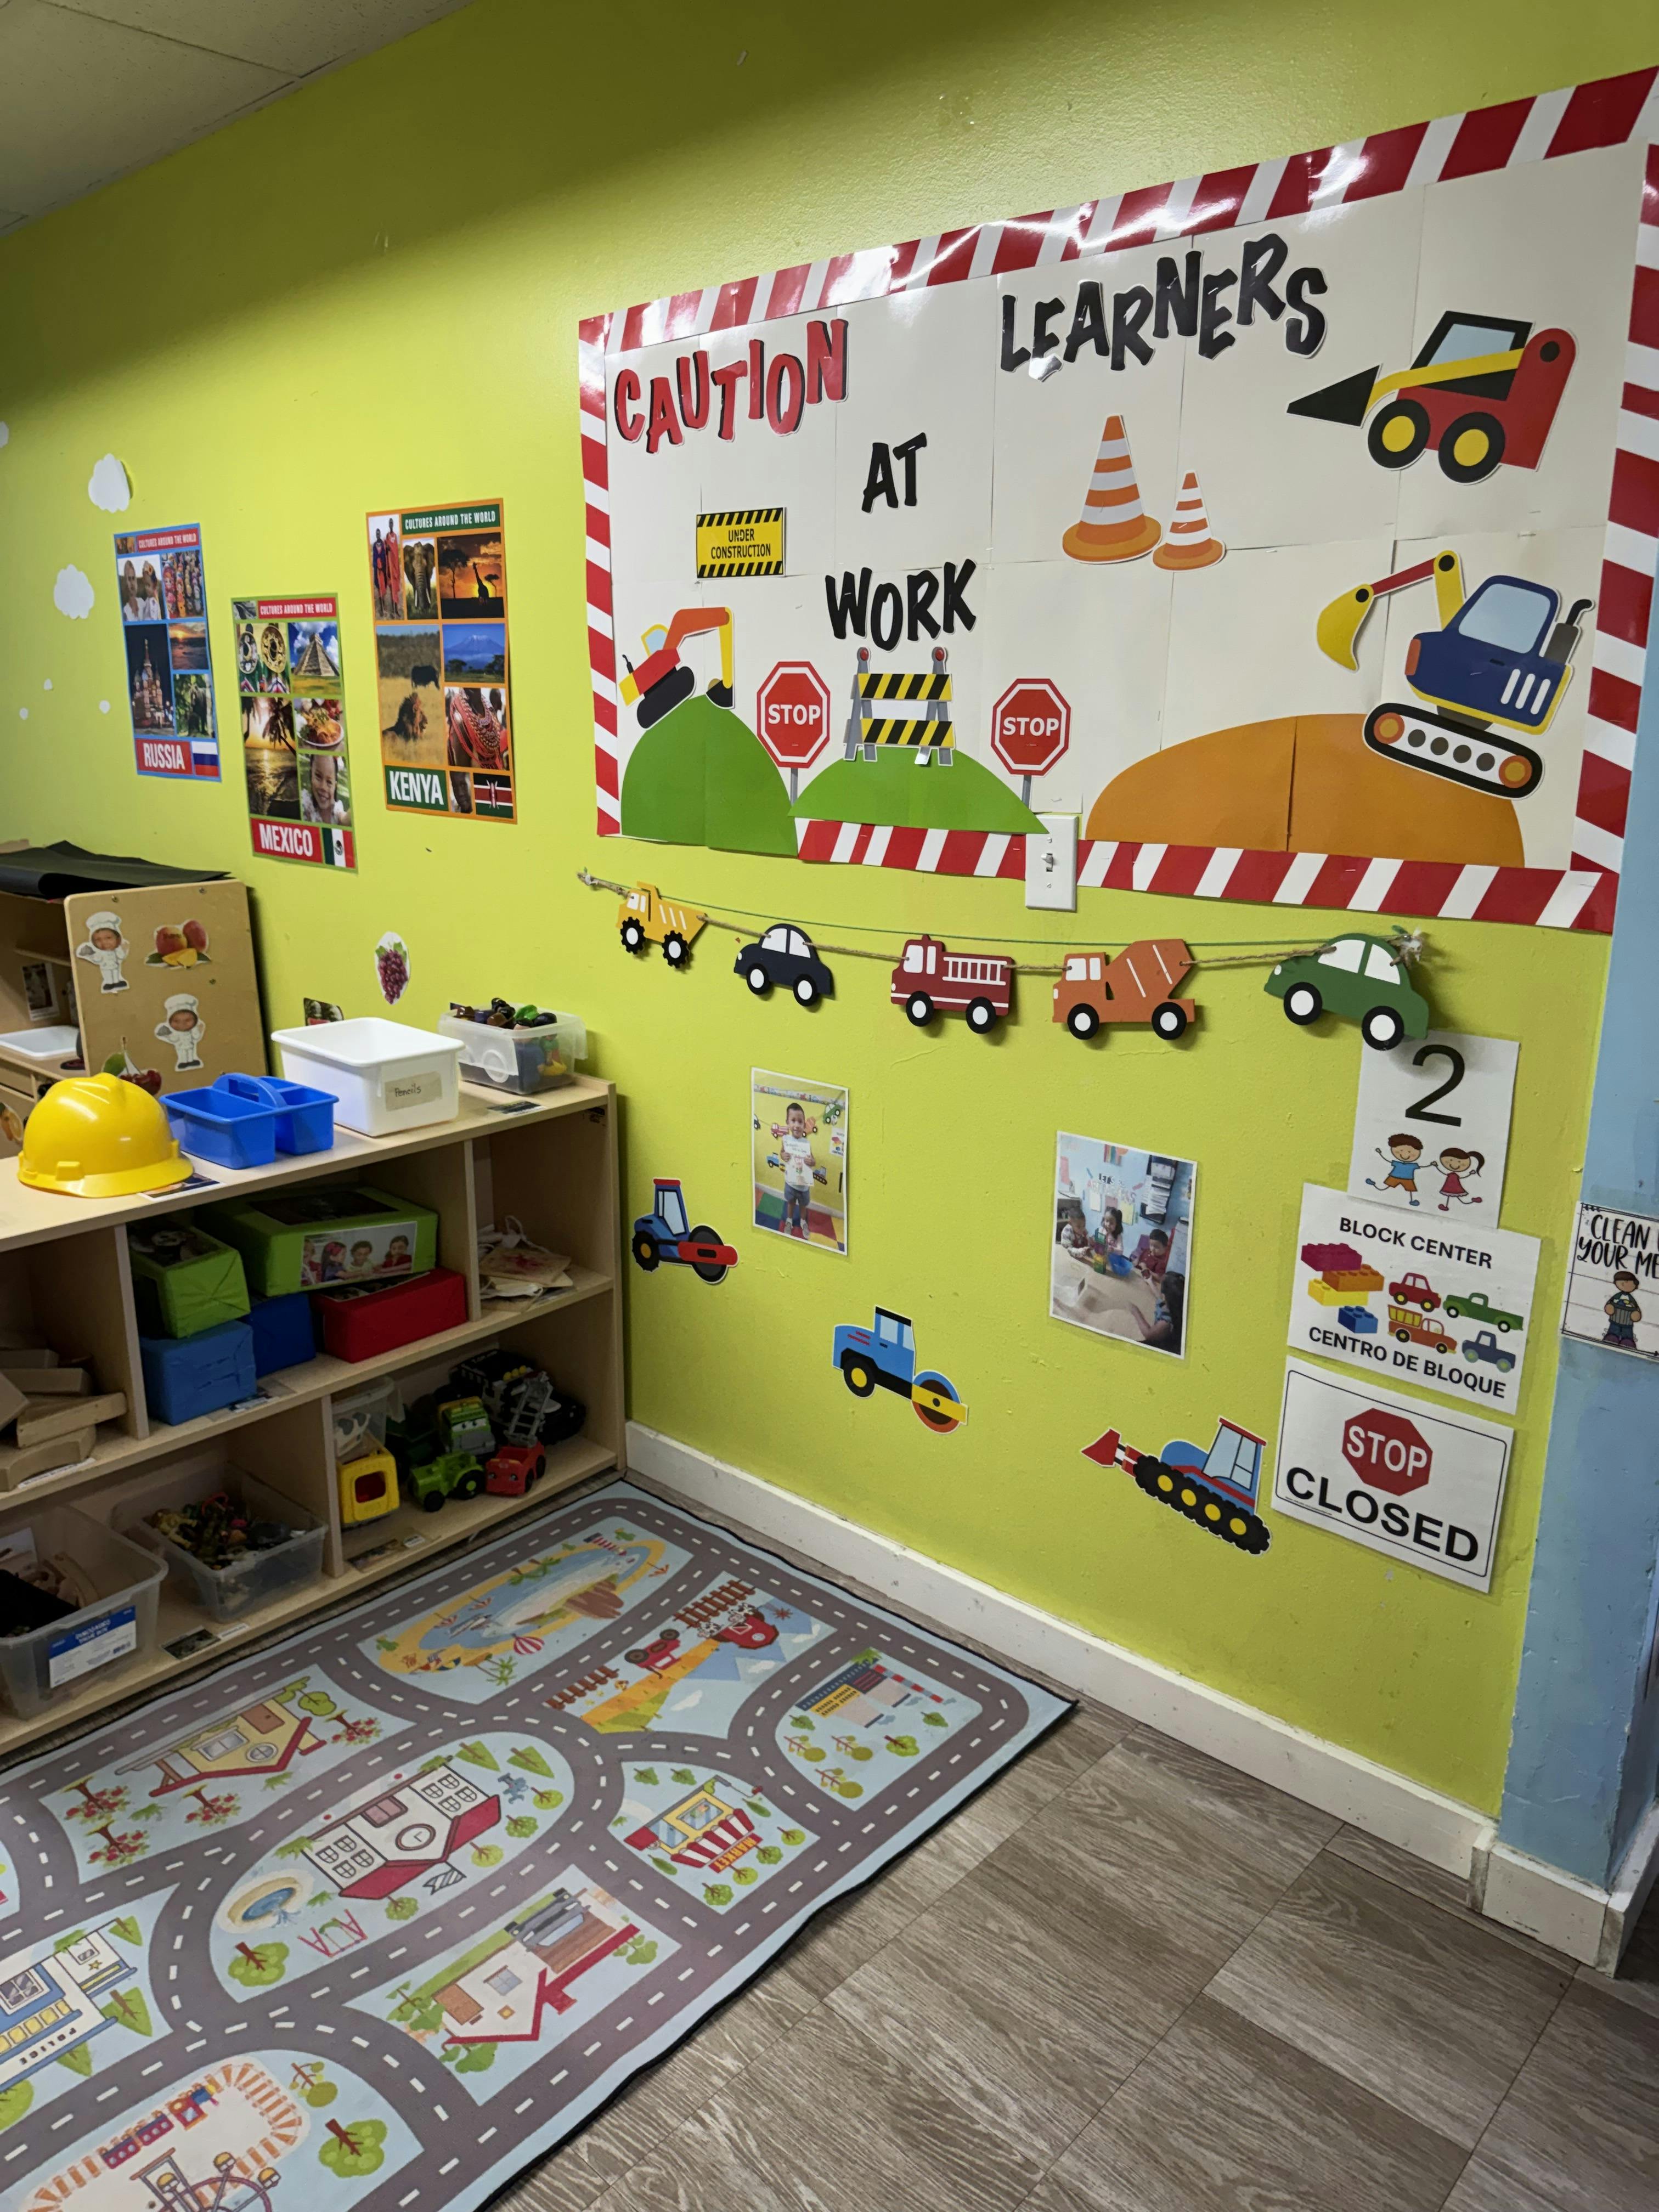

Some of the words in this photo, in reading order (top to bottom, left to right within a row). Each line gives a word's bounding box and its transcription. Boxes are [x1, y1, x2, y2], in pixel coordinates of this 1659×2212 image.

[615, 319, 848, 454] CAUTION
[1001, 234, 1328, 381] LEARNERS
[862, 432, 927, 512] AT
[405, 516, 433, 530] CULTURES
[435, 514, 459, 527] AROUND
[460, 512, 472, 524] THE
[473, 511, 496, 523] WORLD
[729, 528, 754, 542] UNDER
[174, 534, 183, 545] THE
[711, 543, 771, 559] CONSTRUCTION
[260, 605, 283, 615] CULTURES
[284, 604, 303, 614] AROUND
[304, 603, 314, 613] THE
[315, 602, 333, 613] WORLD
[826, 559, 977, 651] WORK
[768, 704, 821, 725] STOP
[1003, 717, 1059, 736] STOP
[143, 742, 185, 770] RUSSIA
[390, 770, 444, 805] KENYA
[259, 823, 313, 857] MEXICO
[394, 1083, 422, 1097] Pencils
[1405, 1044, 1465, 1127] 2
[1339, 1216, 1407, 1249] BLOCK
[1410, 1232, 1493, 1269] CENTER
[1590, 1214, 1650, 1250] CLEAN
[1577, 1237, 1628, 1269] YOUR
[1309, 1326, 1388, 1364] CENTRO
[1392, 1350, 1420, 1373] DE
[1424, 1360, 1507, 1400] BLOQUE
[1346, 1424, 1427, 1480] STOP
[1285, 1466, 1480, 1563] CLOSED
[713, 1837, 757, 1870] MARKET
[19, 2028, 77, 2064] POLICE
